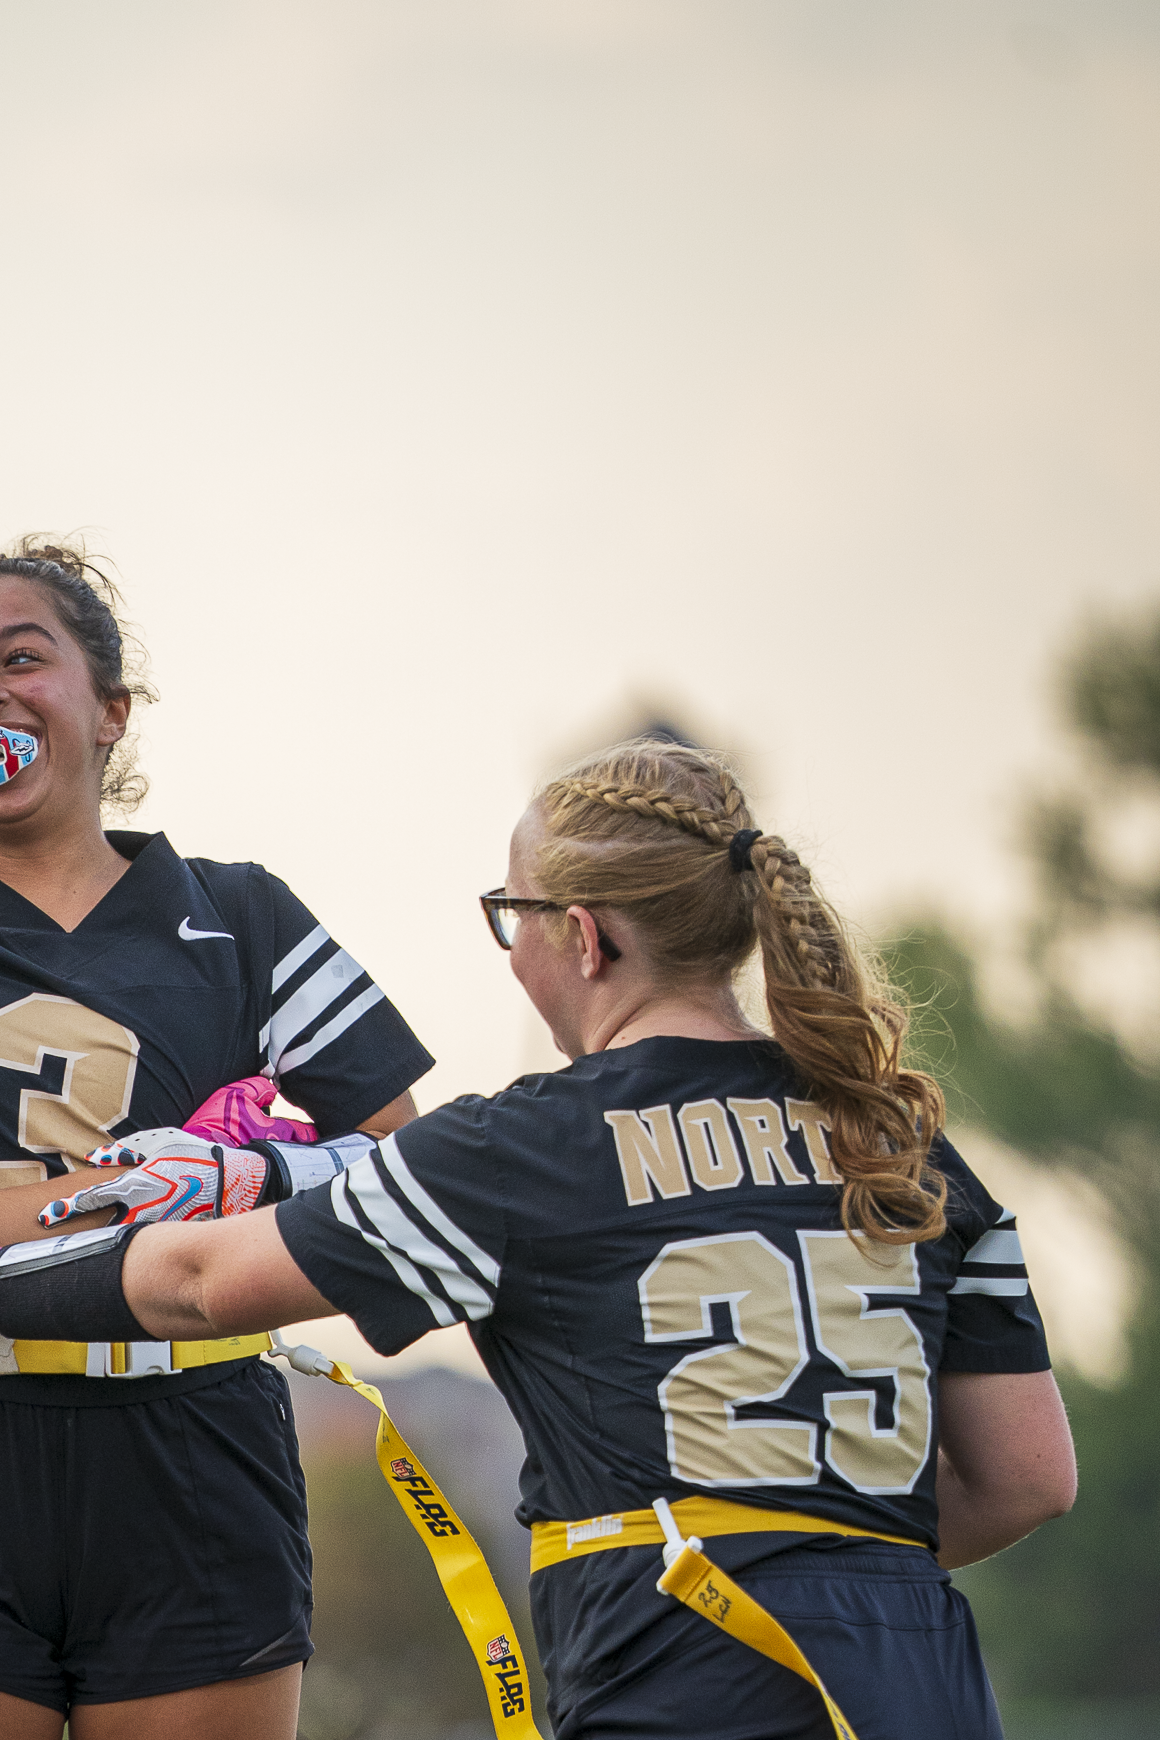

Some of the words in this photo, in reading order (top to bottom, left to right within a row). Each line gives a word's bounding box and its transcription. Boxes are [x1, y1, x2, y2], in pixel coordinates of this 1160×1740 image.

[603, 1097, 843, 1207] NORT
[637, 1229, 932, 1495] 25
[391, 1475, 461, 1537] FLAG
[485, 1655, 525, 1718] FLAG
